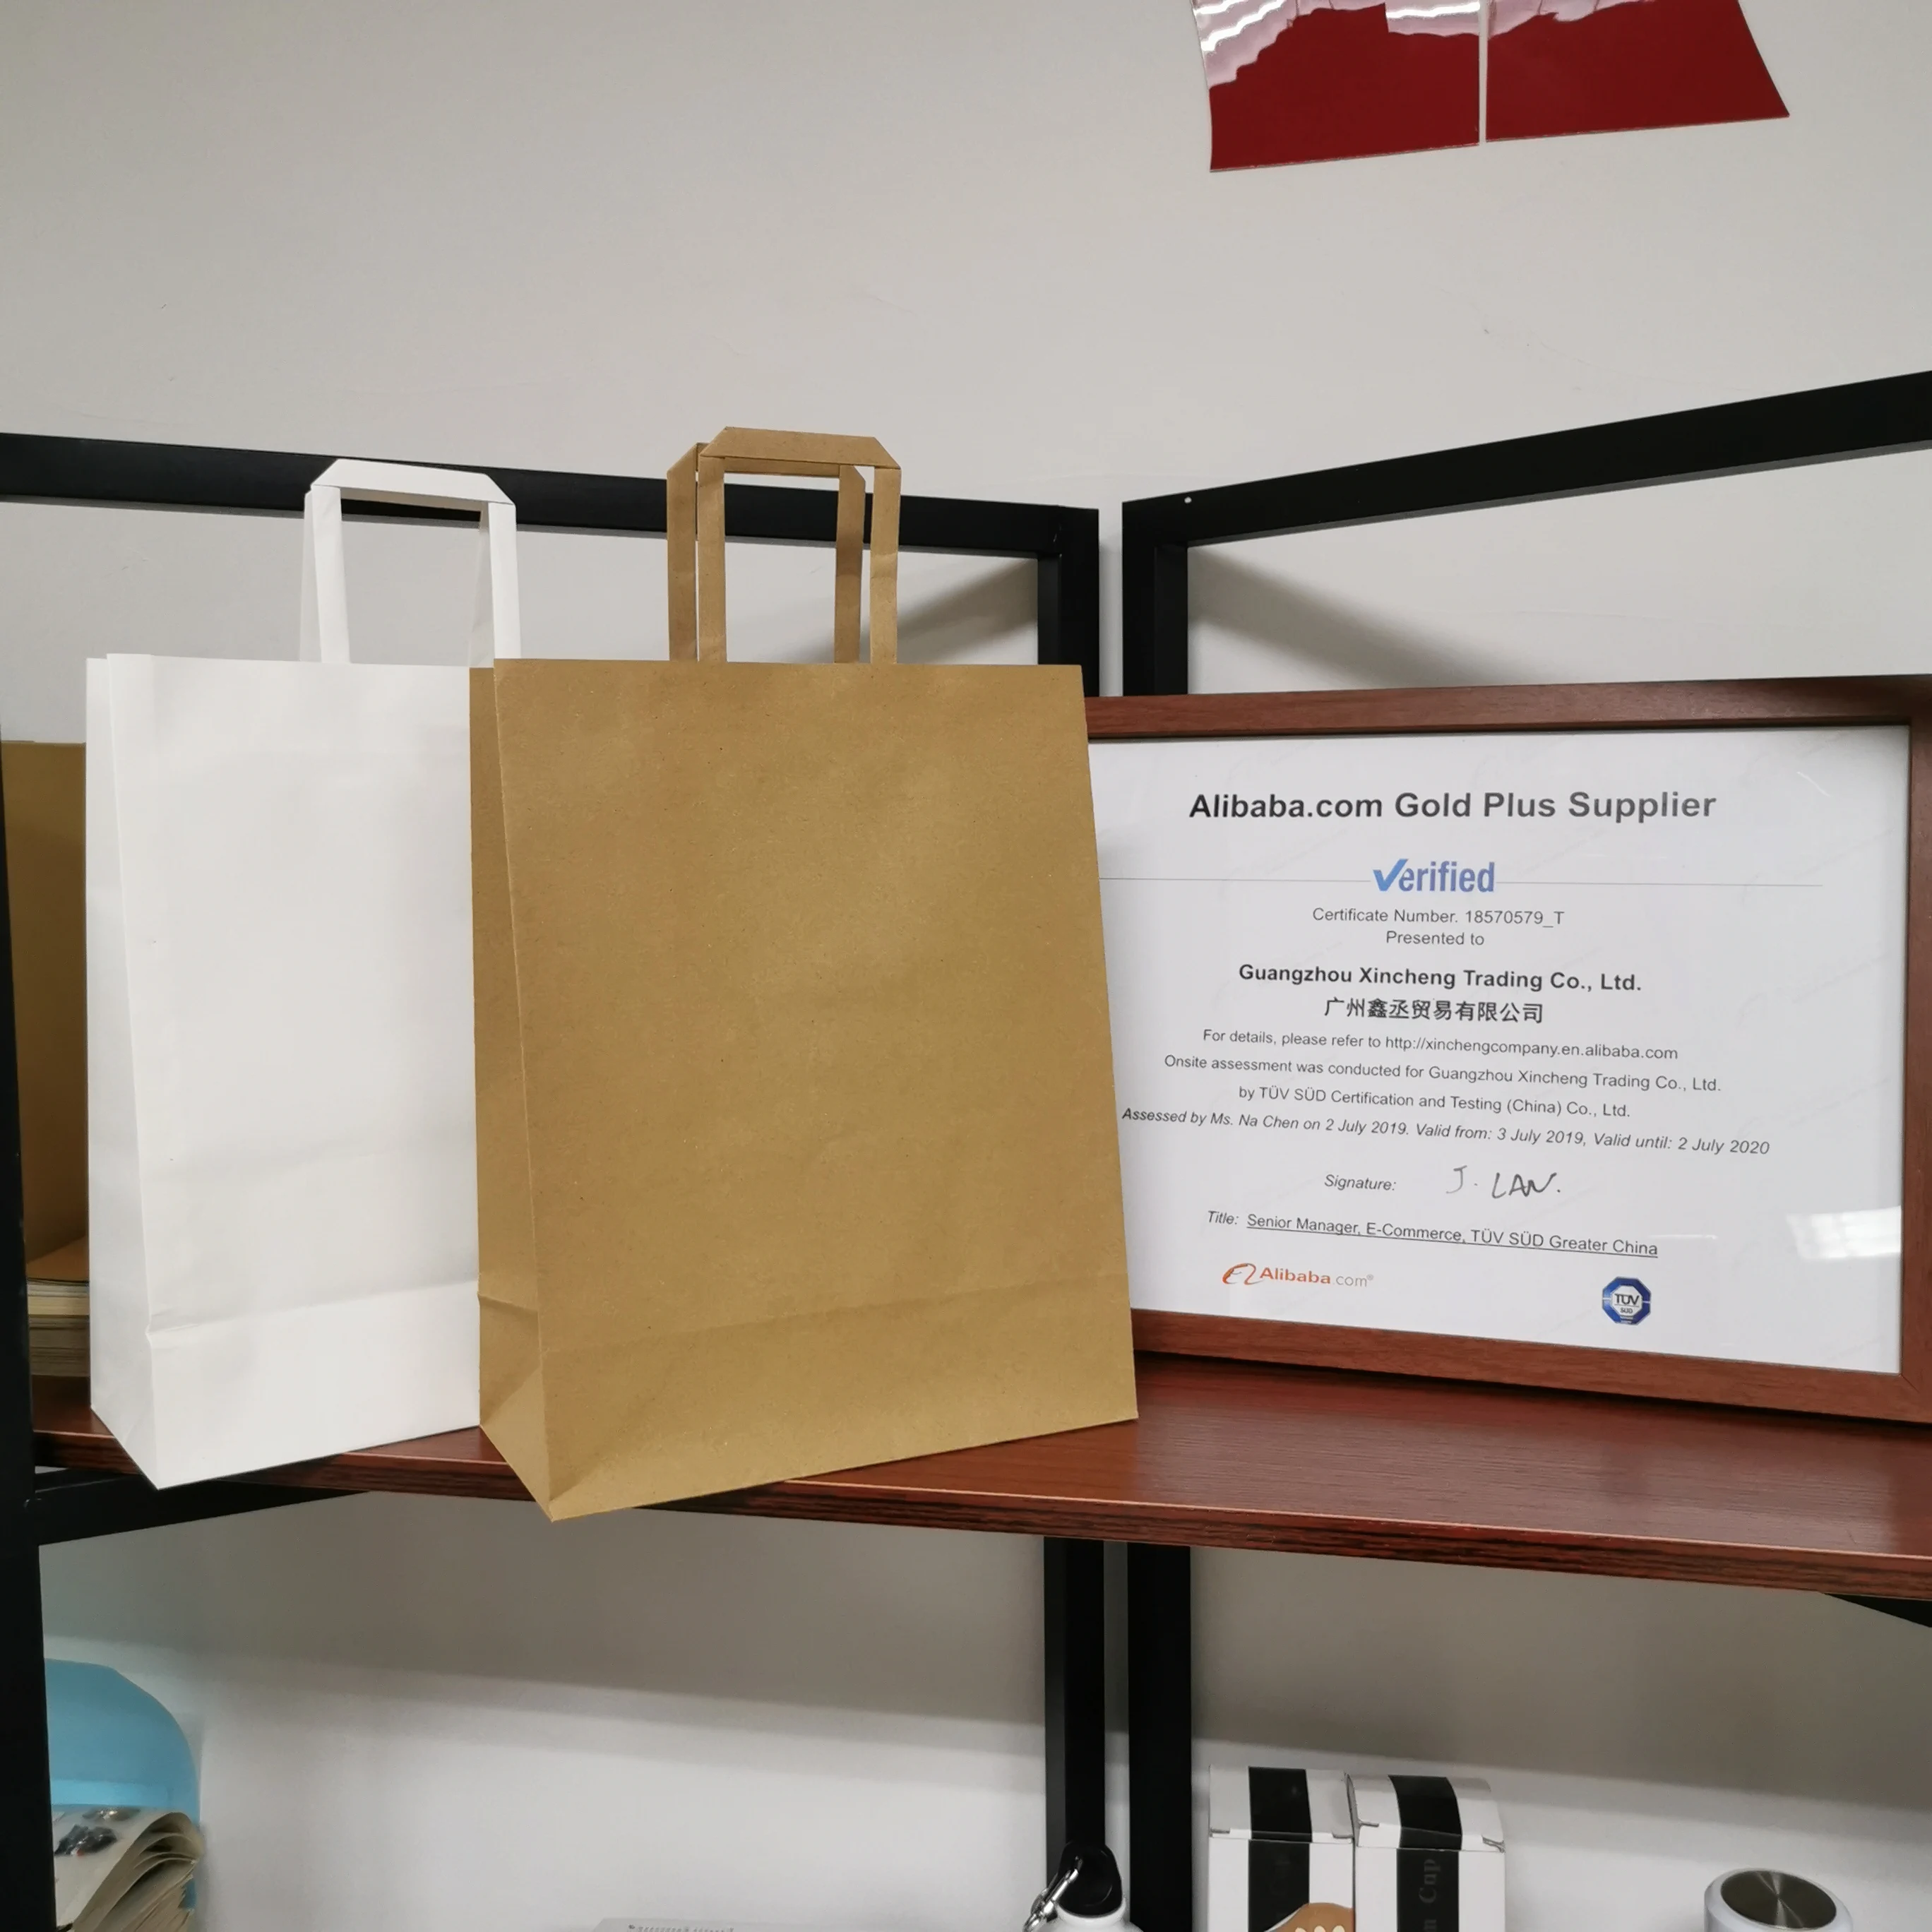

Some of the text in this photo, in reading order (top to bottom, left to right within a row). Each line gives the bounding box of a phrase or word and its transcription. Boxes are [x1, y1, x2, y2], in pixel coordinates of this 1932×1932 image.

[1189, 791, 1717, 824] Alibaba.com Gold Plus Supplier
[1313, 907, 1565, 928] Certificate Number. 18570579_T
[1386, 930, 1484, 946] Presented to
[1239, 964, 1641, 992] Guangzhou Xincheng Trading Co., Ltd.
[1324, 996, 1543, 1024] 广州鑫丞贸易有限公司
[1203, 1029, 1678, 1059] For details, please refer to http://xinchengcompany.en.alibaba.com
[1164, 1054, 1720, 1091] Onsite assessment was conducted for Guangzhou Xincheng Trading Co., Ltd.
[1239, 1085, 1630, 1117] by TÜV SÜD Certification and Testing (China) Co., Ltd.
[1122, 1108, 1770, 1155] Assessed by Ms. Na Chen on 2 July 2019. Valid from: 3 July 2019, Valid until: 2 July 2020
[1324, 1174, 1396, 1191] Signature:
[1208, 1210, 1658, 1256] Title: Senior Manager, E-Commerce, TÜV SÜD Greater China
[1419, 1859, 1441, 1903] Cup
